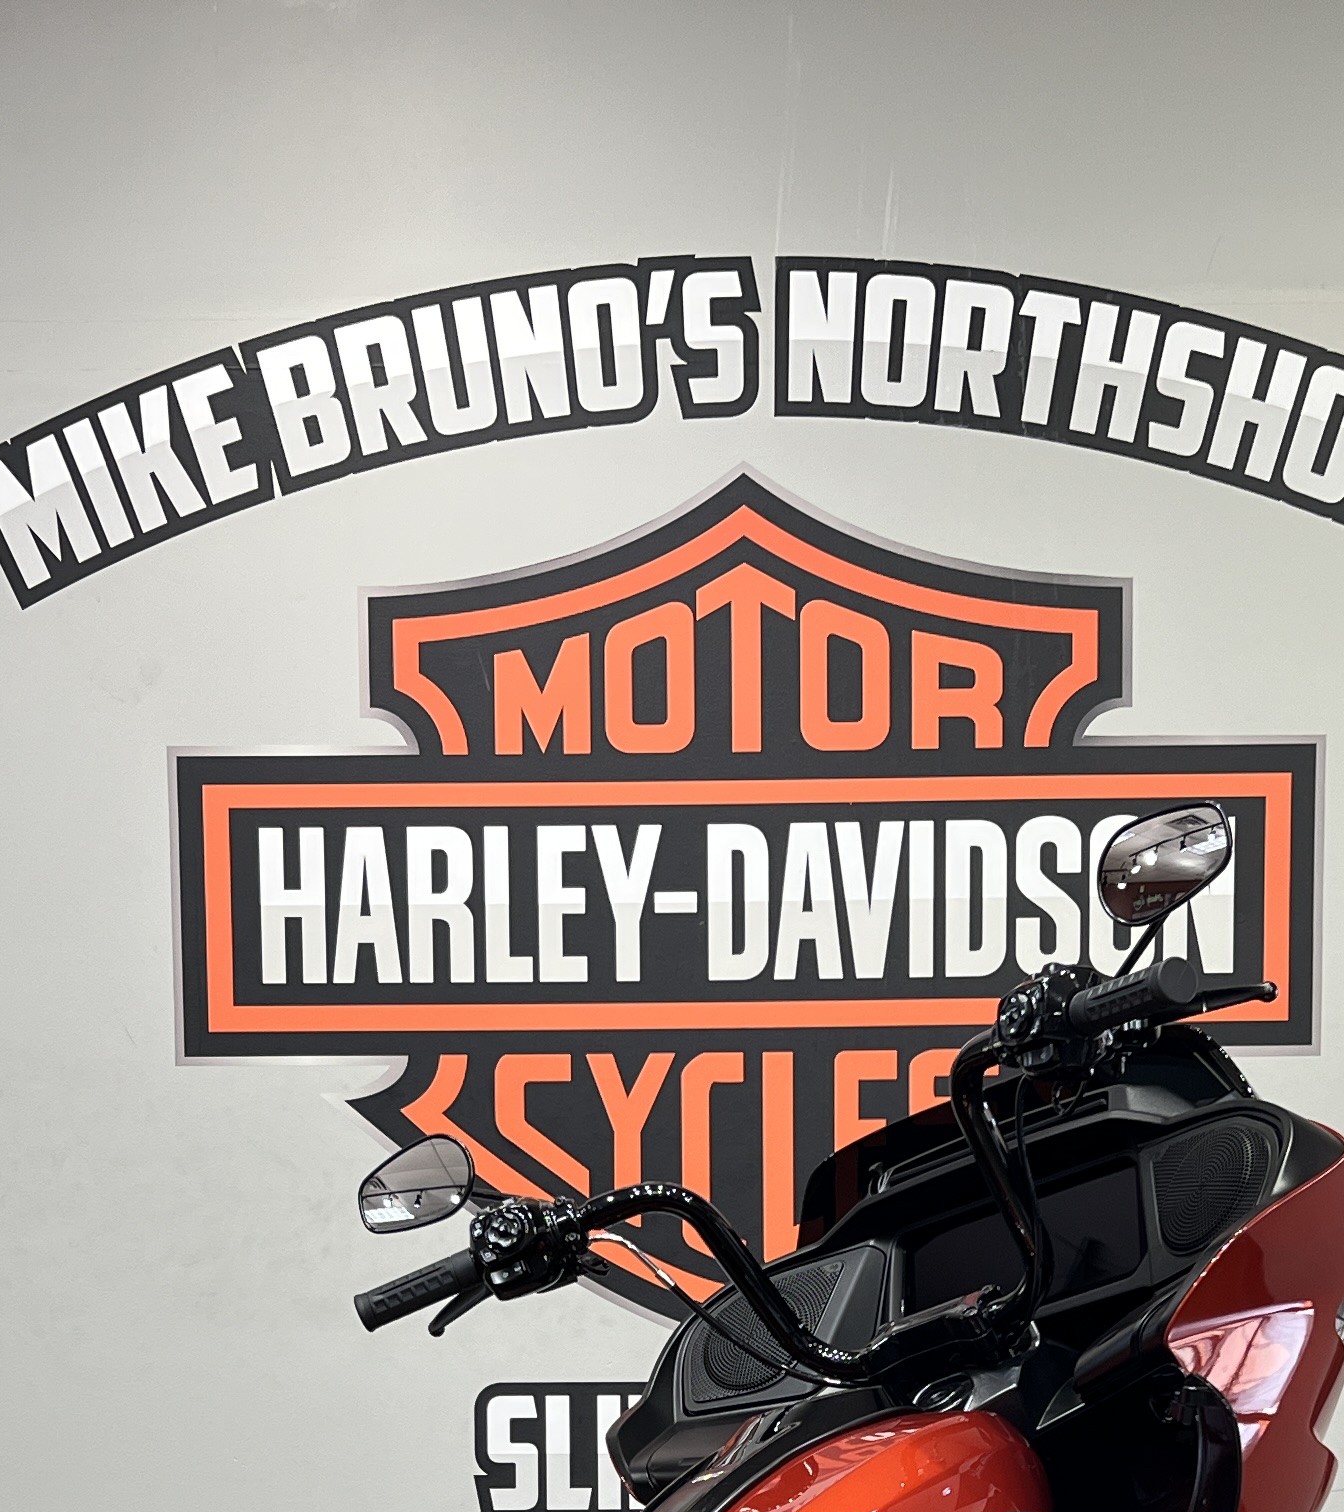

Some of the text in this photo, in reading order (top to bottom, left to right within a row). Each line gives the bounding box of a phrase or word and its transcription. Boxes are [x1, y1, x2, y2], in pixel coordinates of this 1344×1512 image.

[254, 268, 746, 479] BRUNO'S
[493, 562, 1005, 756] MOTOR
[485, 1393, 647, 1512] SLI
